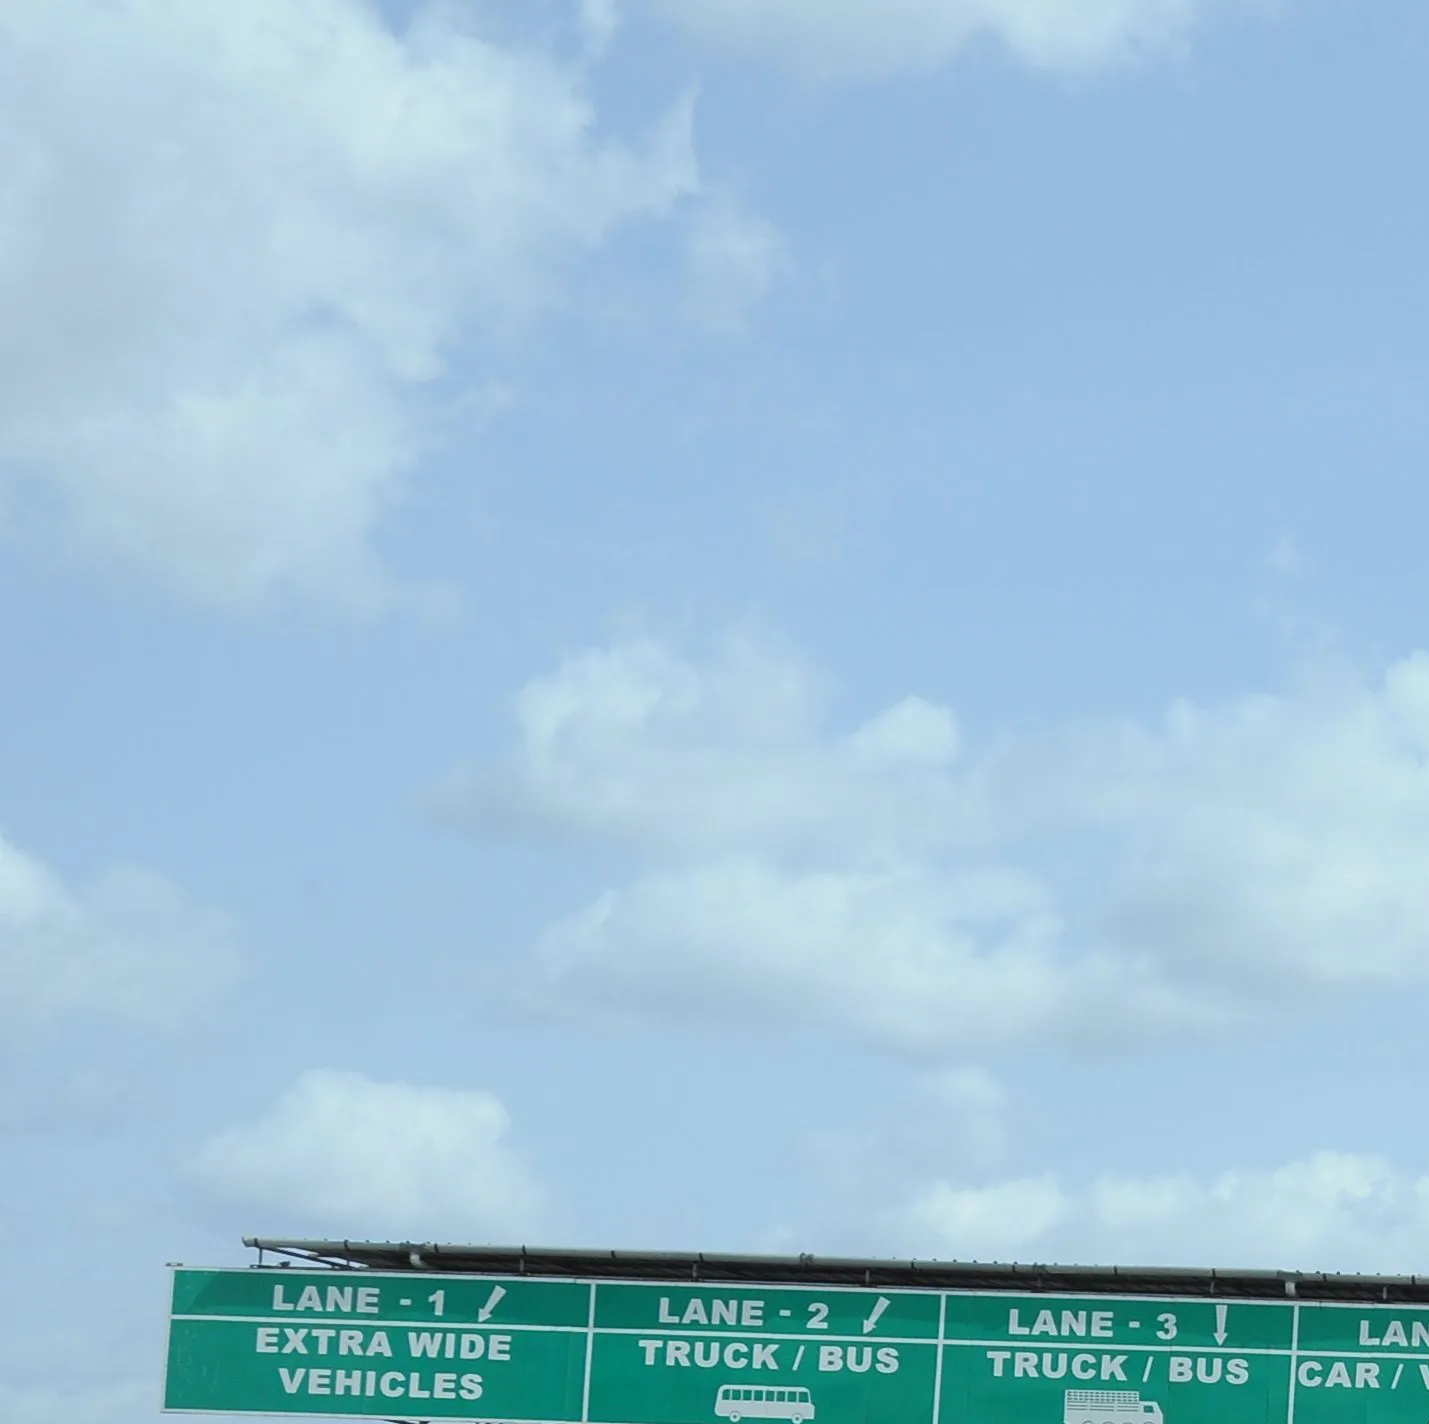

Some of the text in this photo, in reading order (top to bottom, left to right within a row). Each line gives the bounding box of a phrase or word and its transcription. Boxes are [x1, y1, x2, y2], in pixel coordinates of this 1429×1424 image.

[273, 1285, 379, 1313] LANE
[430, 1291, 443, 1315] 1
[660, 1298, 764, 1325] LANE
[807, 1303, 828, 1328] 2
[1009, 1309, 1113, 1336] LANE
[1158, 1314, 1176, 1339] 3
[257, 1328, 511, 1360] EXTRA WIDE
[640, 1340, 779, 1369] TRUCK
[820, 1346, 898, 1373] BUS
[988, 1351, 1127, 1380] TRUCK
[1169, 1357, 1248, 1384] BUS
[1298, 1361, 1379, 1388] CAR
[280, 1368, 482, 1399] VEHICLES
